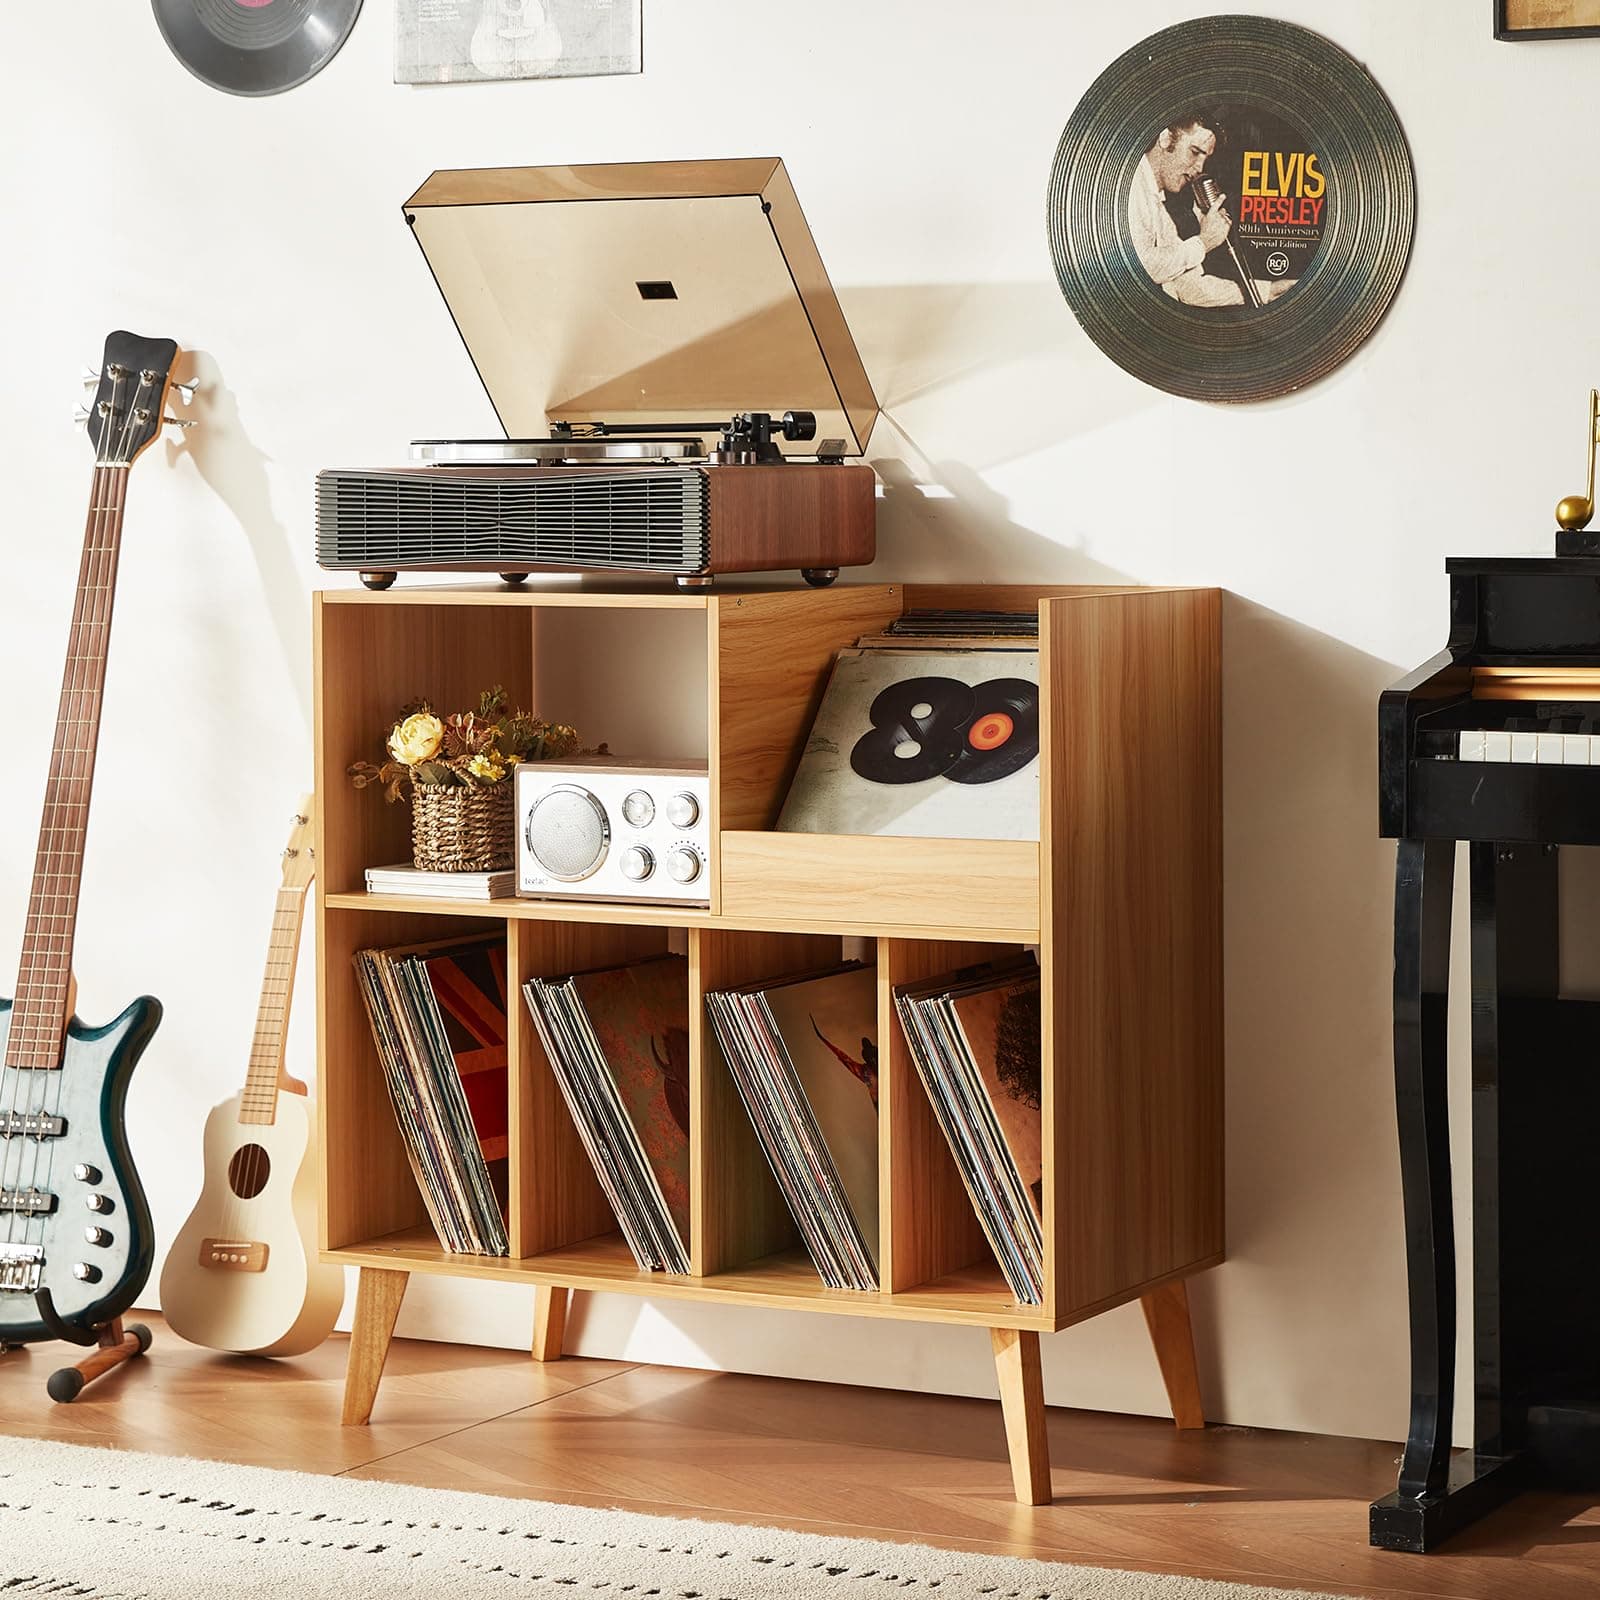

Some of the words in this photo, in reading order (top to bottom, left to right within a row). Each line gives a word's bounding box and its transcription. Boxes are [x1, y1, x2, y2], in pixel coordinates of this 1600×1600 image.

[1241, 151, 1326, 199] ELVIS
[1240, 195, 1324, 225] PRESLEY
[1238, 224, 1260, 234] 80th
[1265, 225, 1320, 239] Anniversary
[1250, 240, 1278, 249] Special
[1279, 240, 1307, 249] Edition
[1269, 259, 1287, 271] RCA
